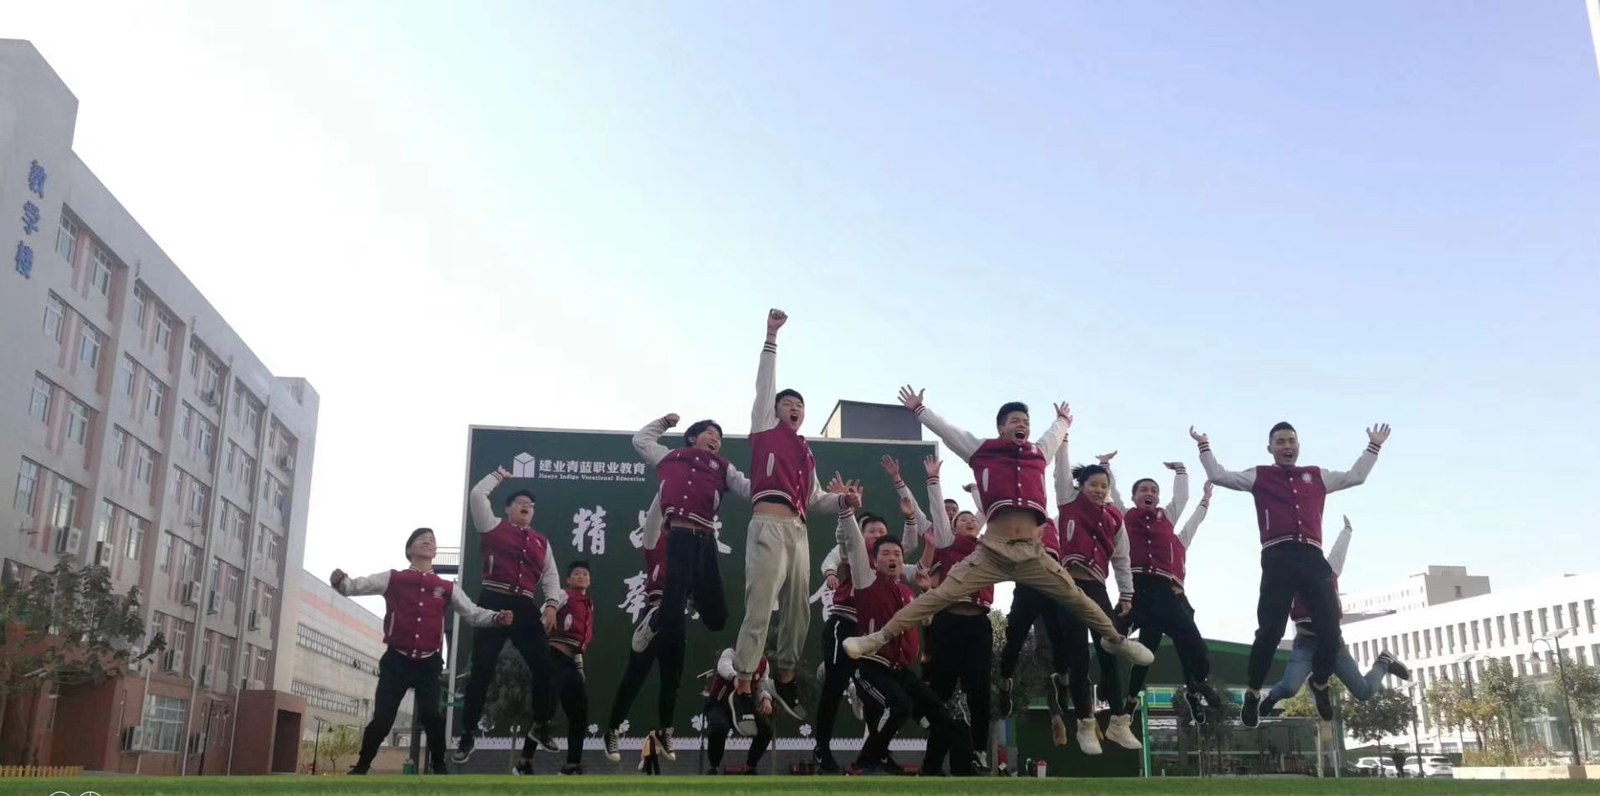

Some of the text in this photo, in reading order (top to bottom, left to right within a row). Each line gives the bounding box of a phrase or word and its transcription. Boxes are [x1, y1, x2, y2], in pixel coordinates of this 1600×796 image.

[15, 159, 47, 280] 教学楼
[539, 459, 645, 475] 建业青蓝职业教育
